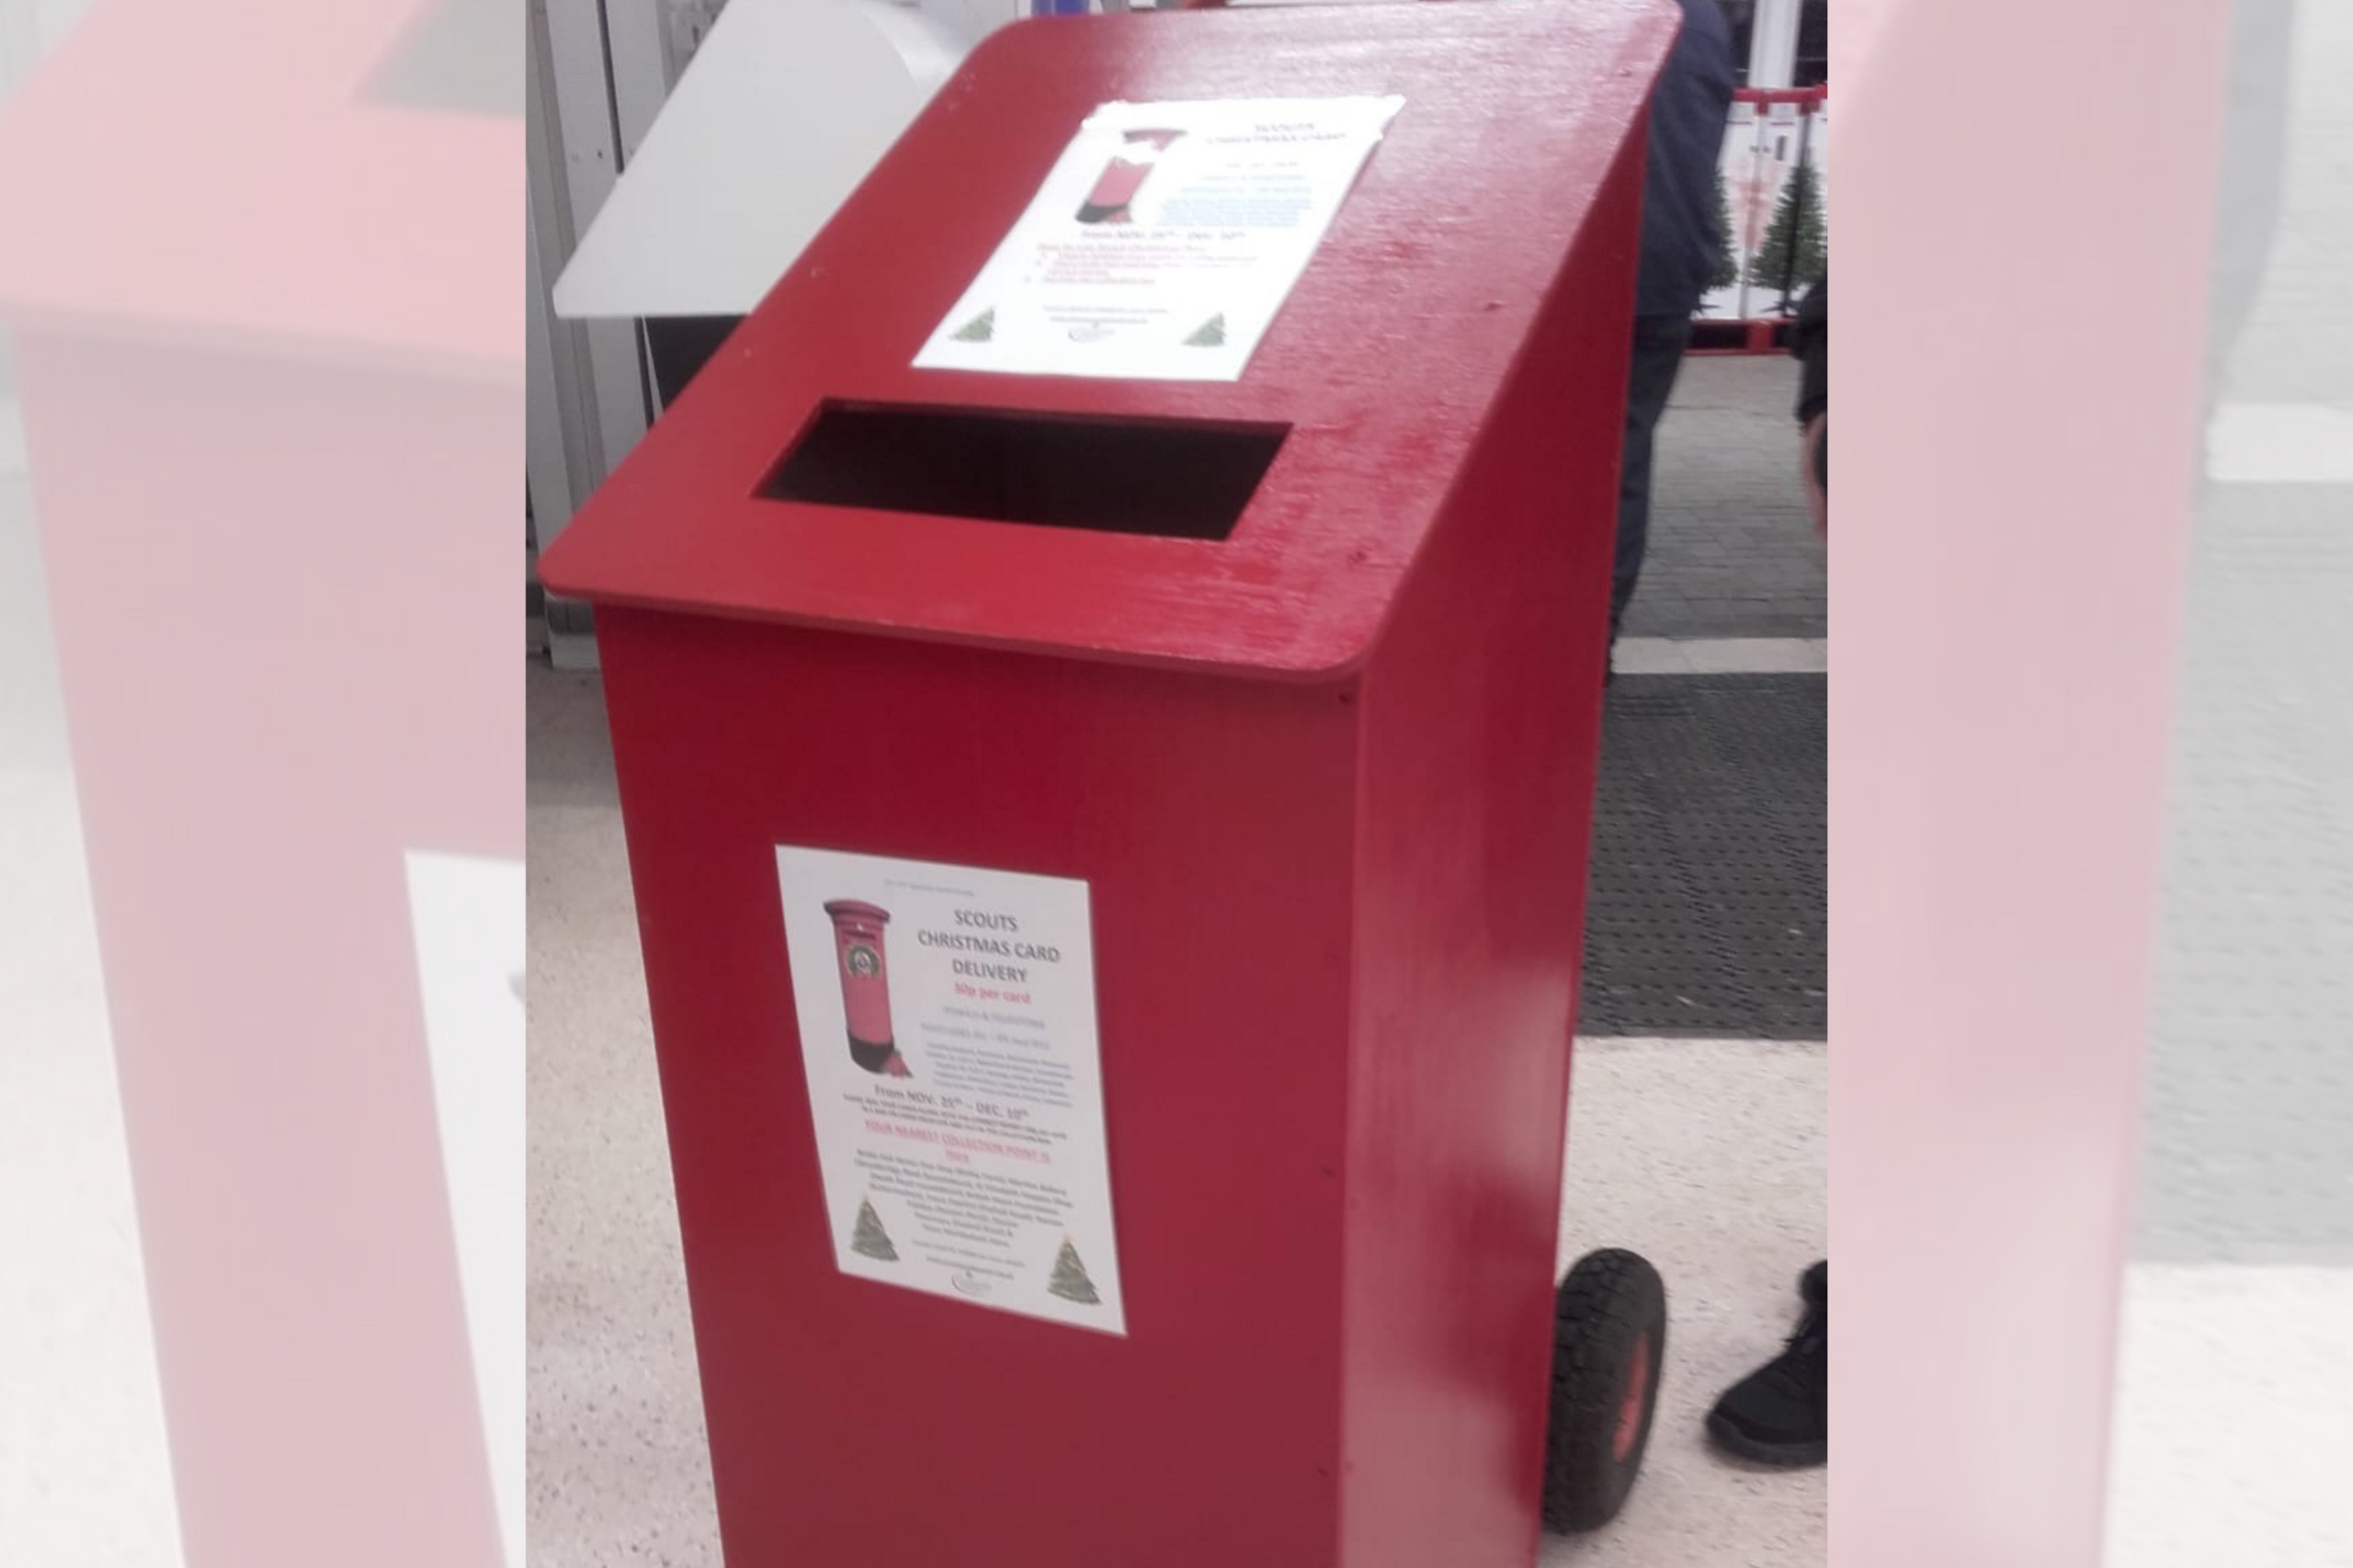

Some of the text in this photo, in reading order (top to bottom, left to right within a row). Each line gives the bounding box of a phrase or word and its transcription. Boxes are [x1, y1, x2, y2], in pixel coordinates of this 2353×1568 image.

[954, 909, 1018, 932] SCOUTS
[917, 928, 1061, 963] CHRISTMAS CARD
[952, 958, 1028, 983] DELIVERY
[874, 1084, 904, 1100] From
